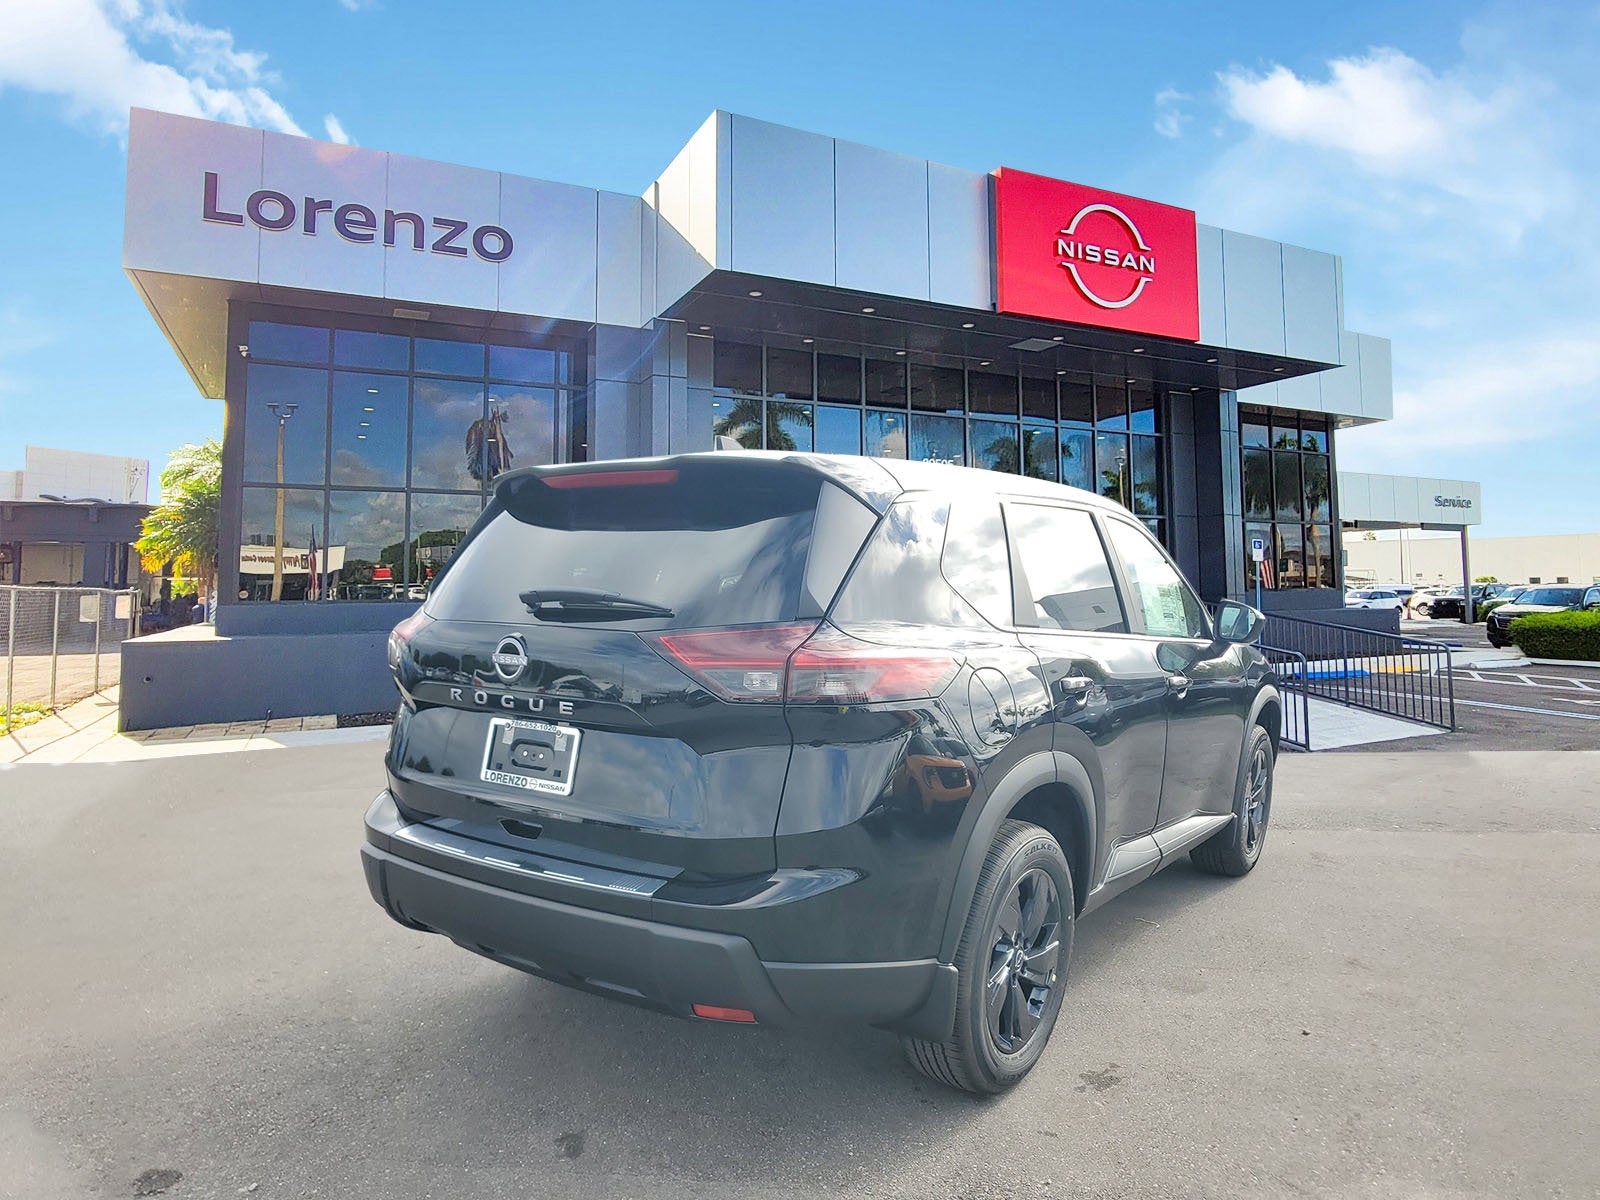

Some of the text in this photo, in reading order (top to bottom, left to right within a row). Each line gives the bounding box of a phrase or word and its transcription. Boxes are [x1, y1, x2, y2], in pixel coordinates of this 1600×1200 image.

[202, 171, 514, 262] Lorenzo
[1057, 238, 1155, 273] NISSAN
[1434, 495, 1472, 508] Service
[493, 654, 528, 667] NISSAN
[450, 687, 574, 715] ROGUE
[484, 771, 566, 793] LORENZO NISSAN
[1023, 842, 1058, 860] FALKEN
